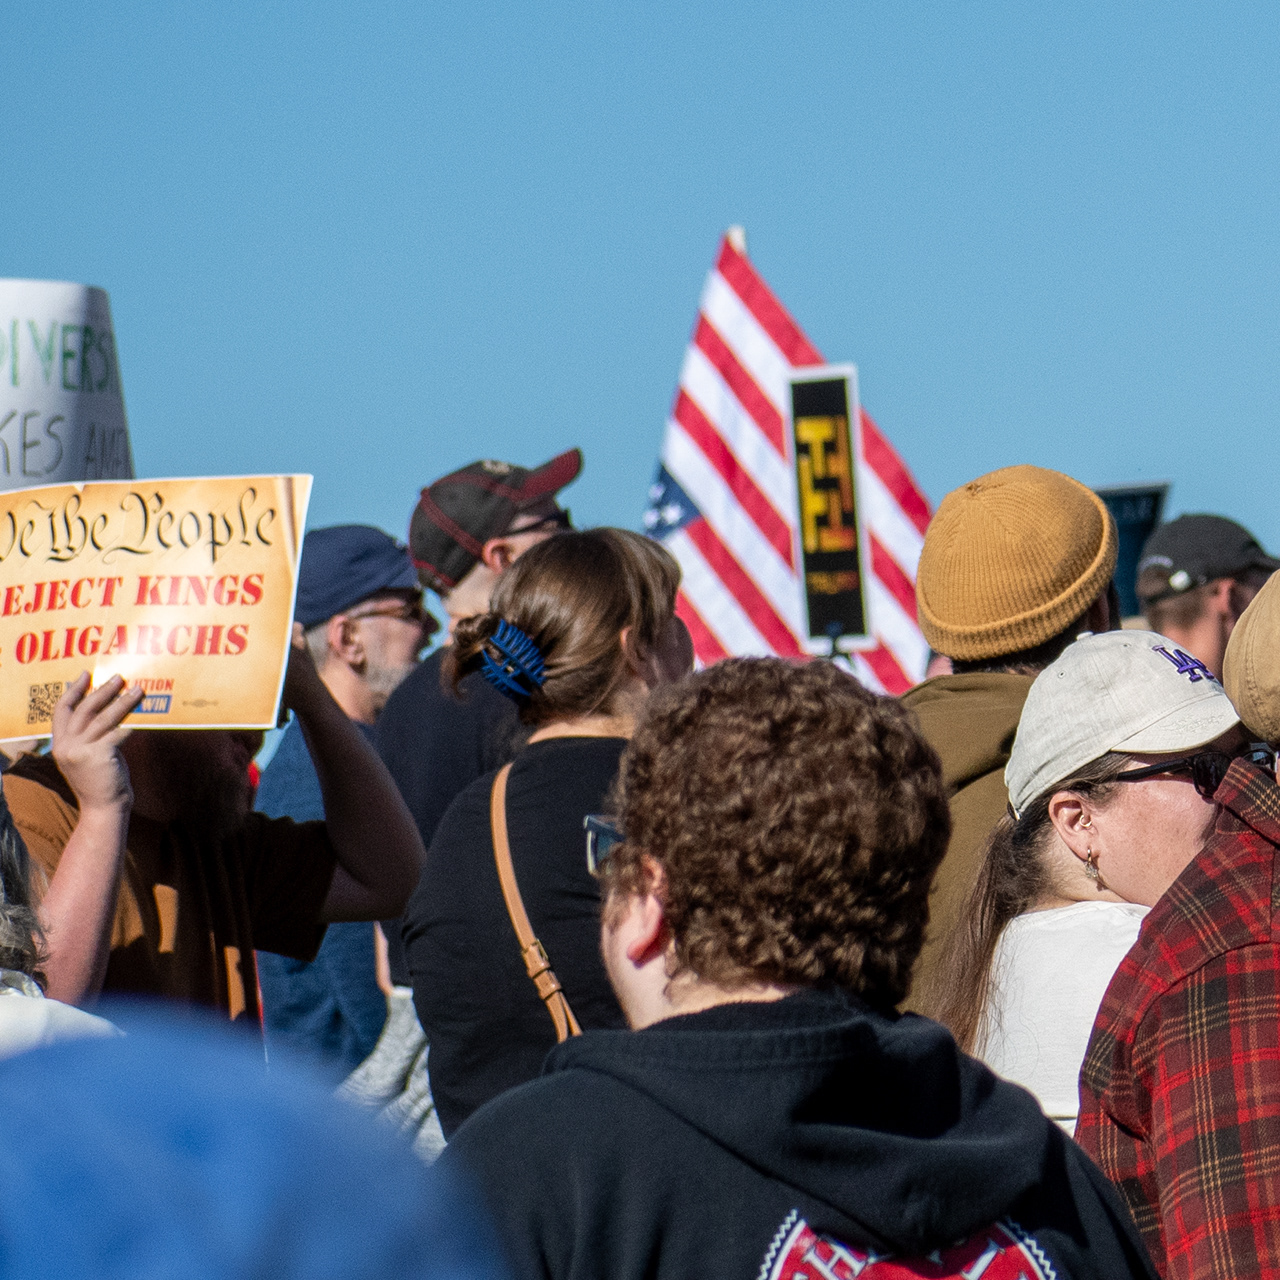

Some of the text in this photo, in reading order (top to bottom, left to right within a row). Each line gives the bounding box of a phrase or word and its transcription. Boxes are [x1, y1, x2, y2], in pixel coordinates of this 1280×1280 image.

[0, 319, 111, 393] IVERS
[26, 493, 109, 563] The
[102, 487, 277, 565] People
[0, 573, 265, 619] EJECT KINGS
[15, 623, 250, 665] OLIGARCHS
[1152, 644, 1215, 683] LA
